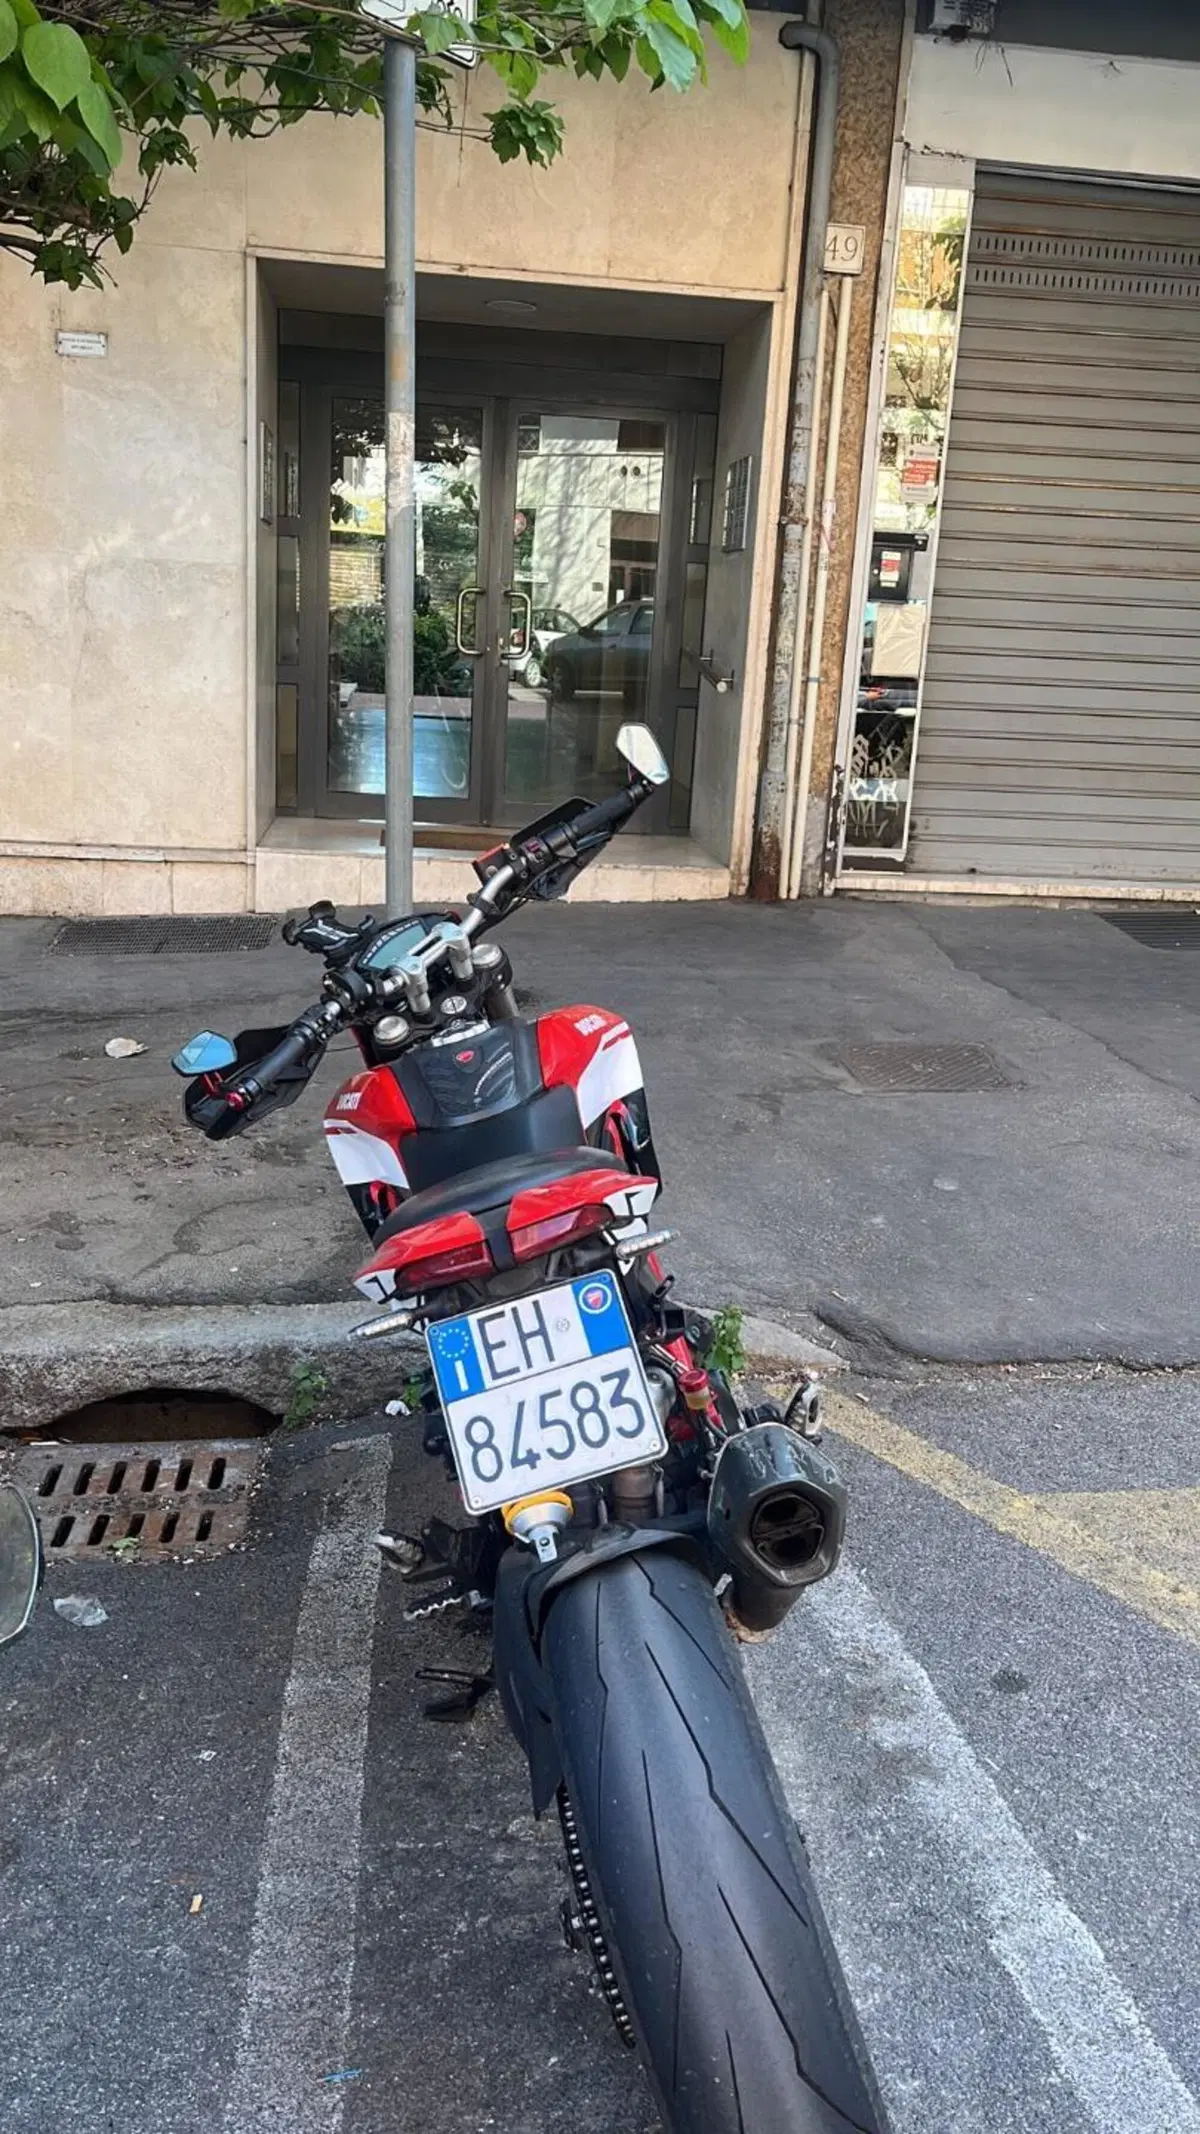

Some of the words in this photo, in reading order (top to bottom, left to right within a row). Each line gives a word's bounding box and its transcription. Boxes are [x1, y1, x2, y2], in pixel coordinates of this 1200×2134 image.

[825, 234, 858, 261] 49
[336, 1091, 362, 1110] DUCATI
[476, 1299, 555, 1381] EH
[454, 1359, 469, 1392] I
[464, 1367, 645, 1483] 84583
